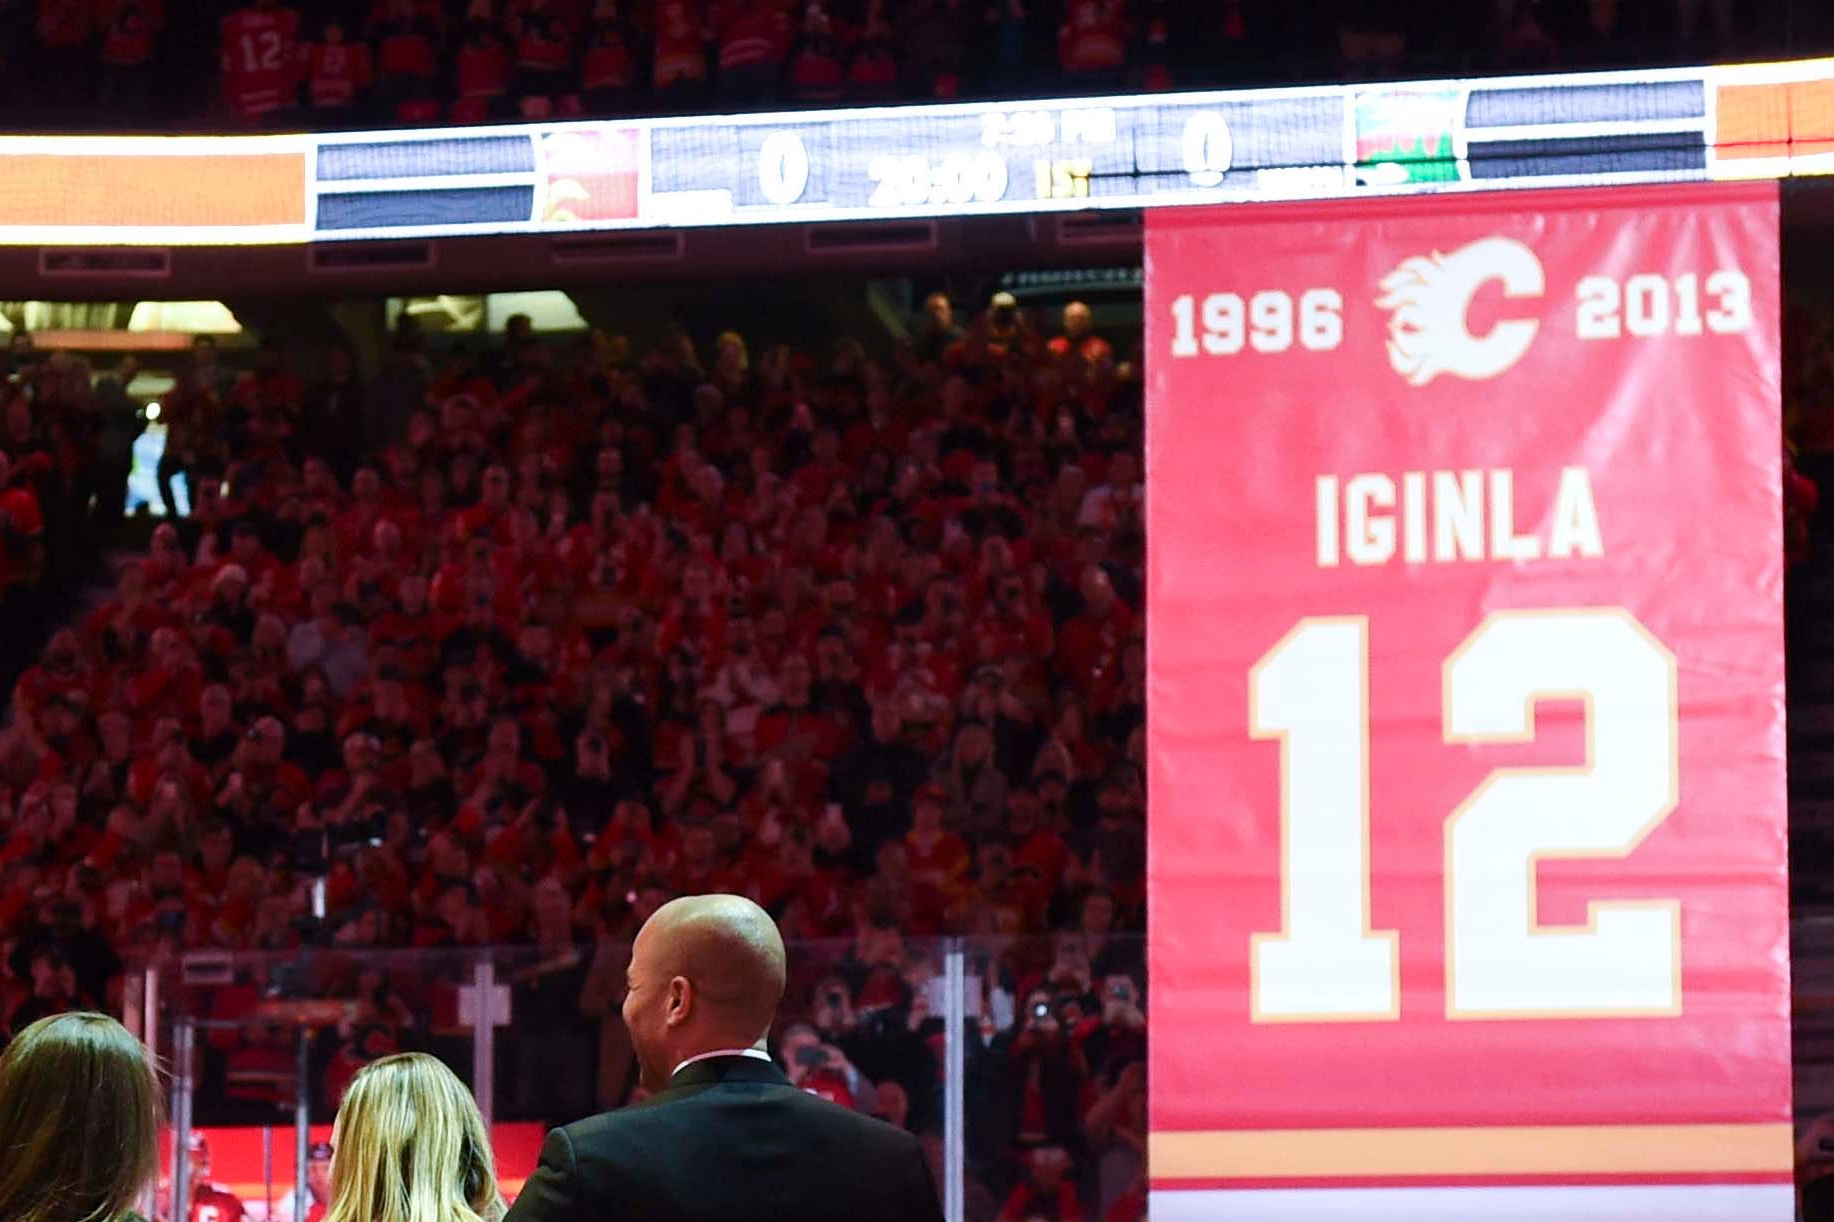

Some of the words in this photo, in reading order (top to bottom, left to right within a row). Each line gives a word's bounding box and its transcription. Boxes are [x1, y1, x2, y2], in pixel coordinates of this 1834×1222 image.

[1171, 288, 1345, 357] 1996
[1575, 270, 1753, 340] 2013
[1315, 465, 1606, 567] IGINLA
[1248, 606, 1684, 1024] 12
